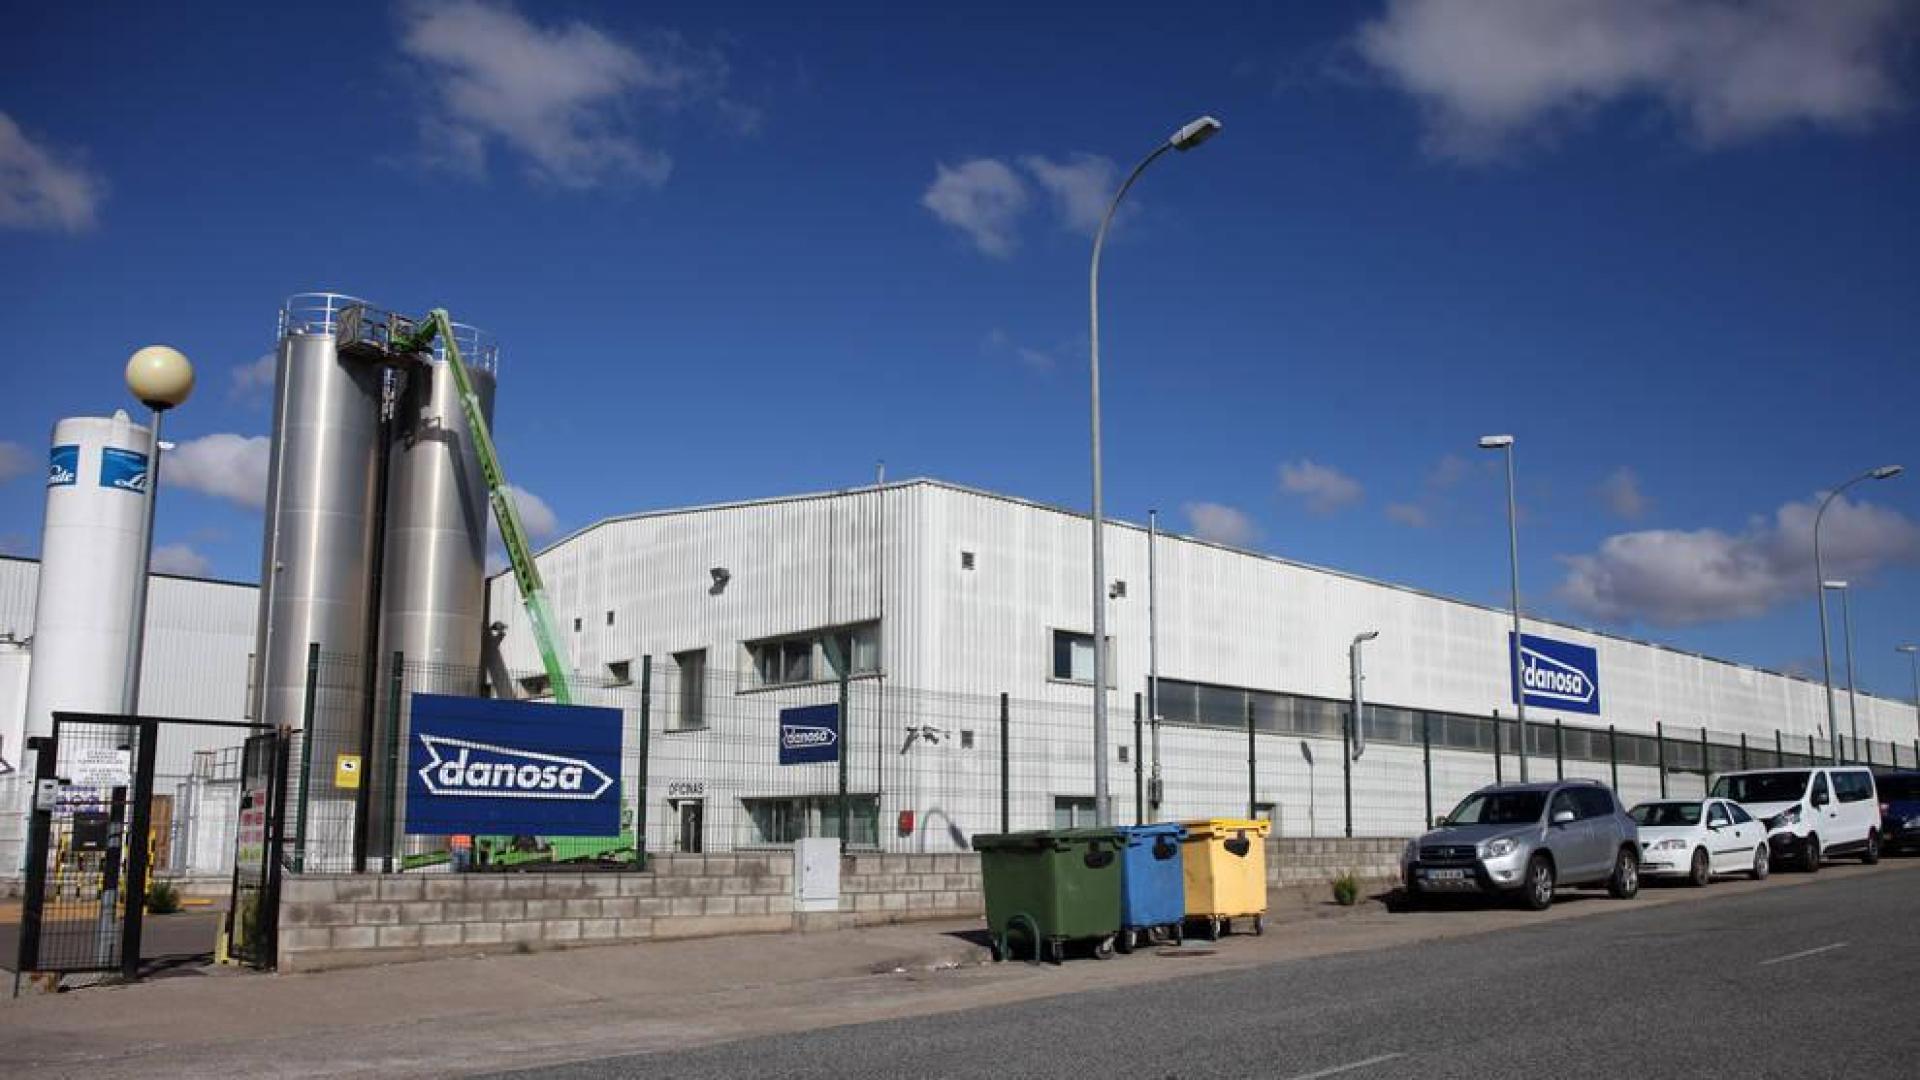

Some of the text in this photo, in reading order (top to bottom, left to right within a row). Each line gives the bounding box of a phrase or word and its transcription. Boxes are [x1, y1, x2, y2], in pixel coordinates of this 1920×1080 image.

[1524, 656, 1582, 694] danosa
[787, 728, 828, 744] danosa
[438, 747, 583, 790] danosa
